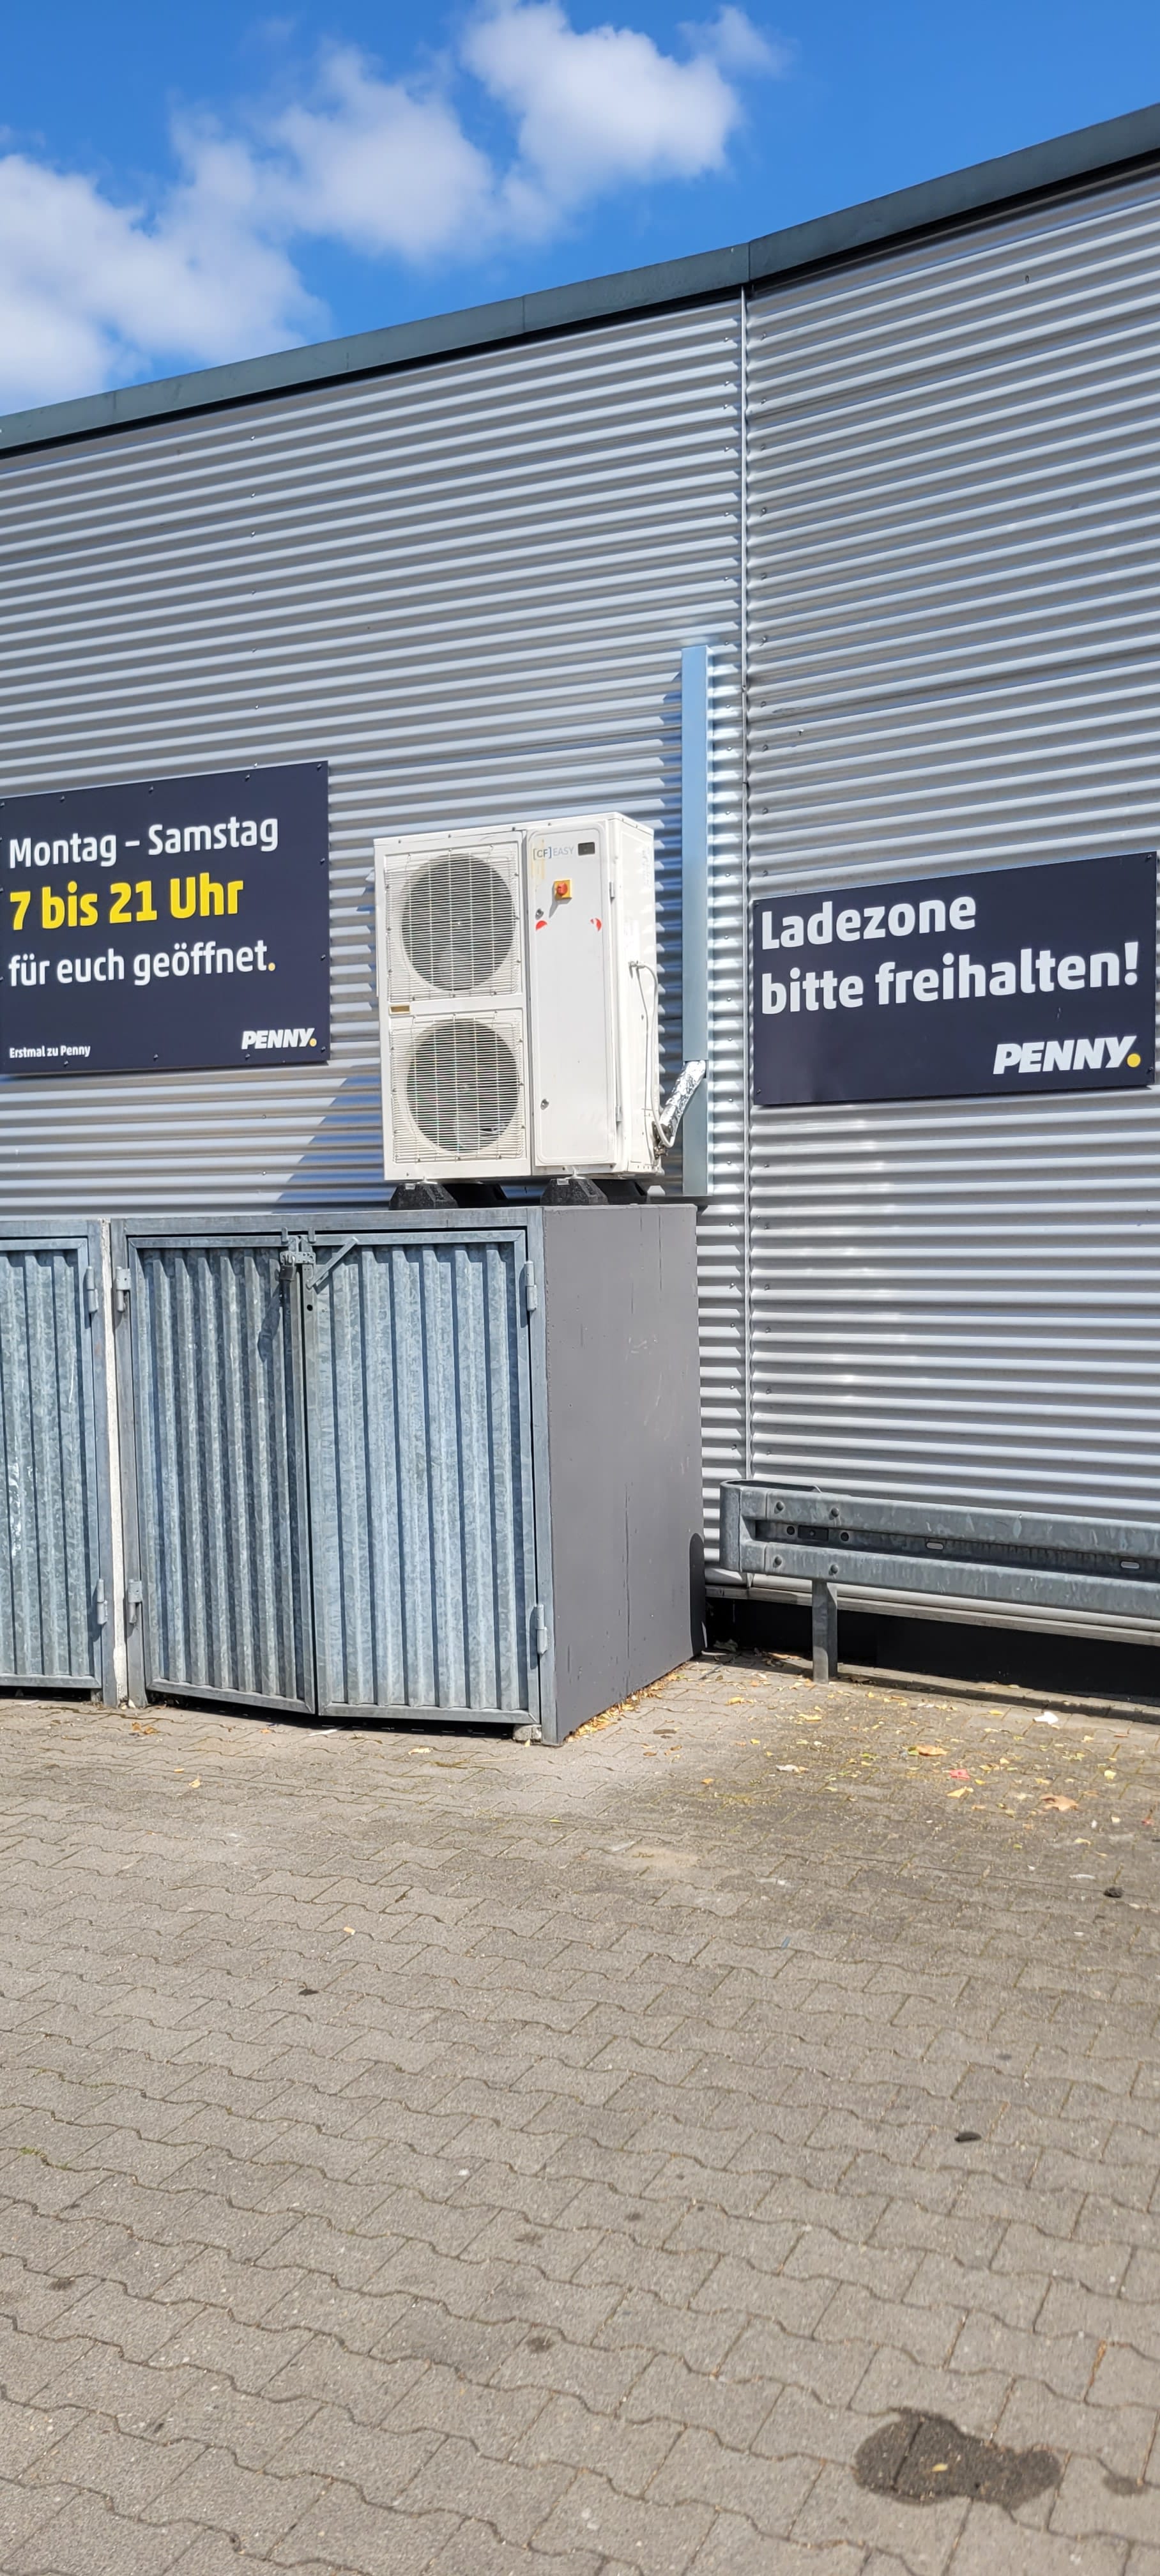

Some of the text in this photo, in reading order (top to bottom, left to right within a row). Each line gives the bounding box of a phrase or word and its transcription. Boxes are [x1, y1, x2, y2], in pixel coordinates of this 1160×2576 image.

[9, 832, 117, 868] Montag
[148, 816, 279, 855] Samstag
[10, 872, 244, 931] 7 bis 21 Uhr
[761, 896, 977, 950] Ladezone
[8, 939, 276, 987] für euch geöffnet.
[761, 941, 1139, 1015] bitte freihalten!
[9, 1044, 91, 1059] Erstmal zu Penny
